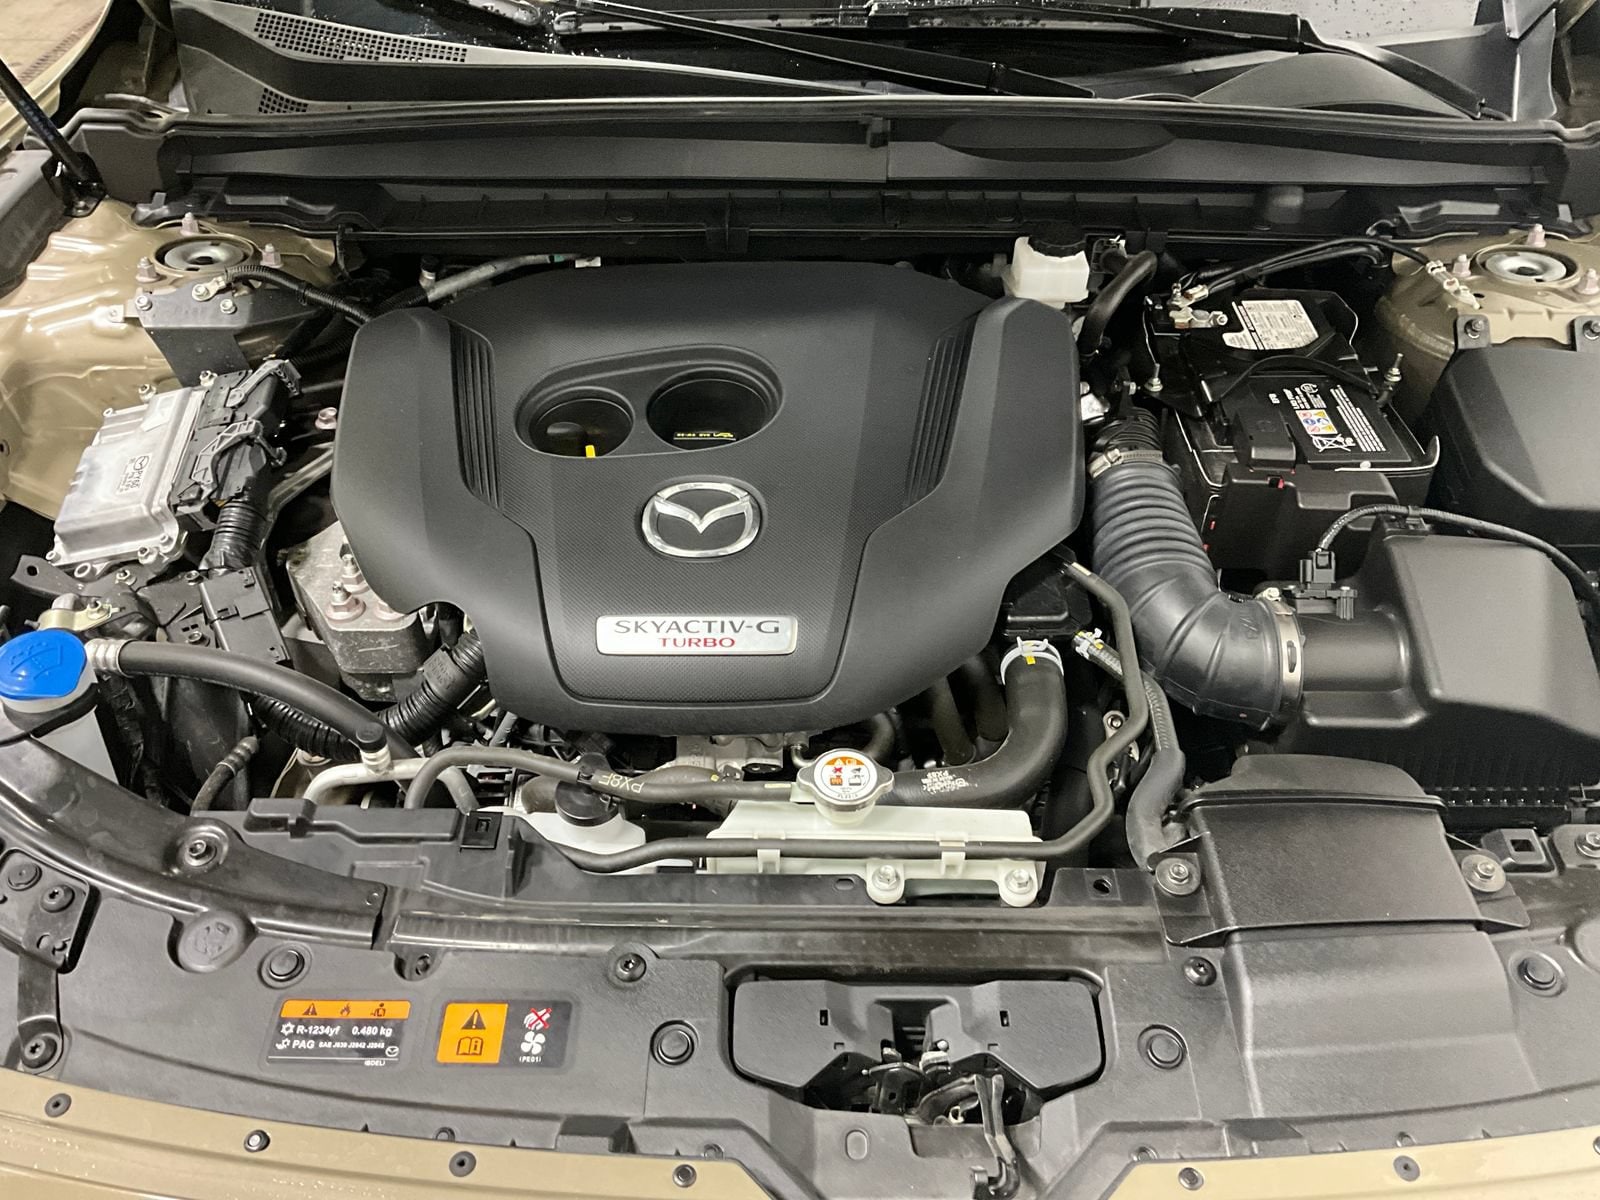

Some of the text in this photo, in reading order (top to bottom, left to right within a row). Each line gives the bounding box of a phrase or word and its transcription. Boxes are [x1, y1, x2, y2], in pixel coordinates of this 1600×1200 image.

[614, 619, 780, 634] SKYACTIV-G
[658, 637, 736, 648] TURBO
[598, 772, 645, 794] PX8F
[296, 1024, 393, 1037] R-1234yf 0.480 kg
[292, 1039, 315, 1049] PAG
